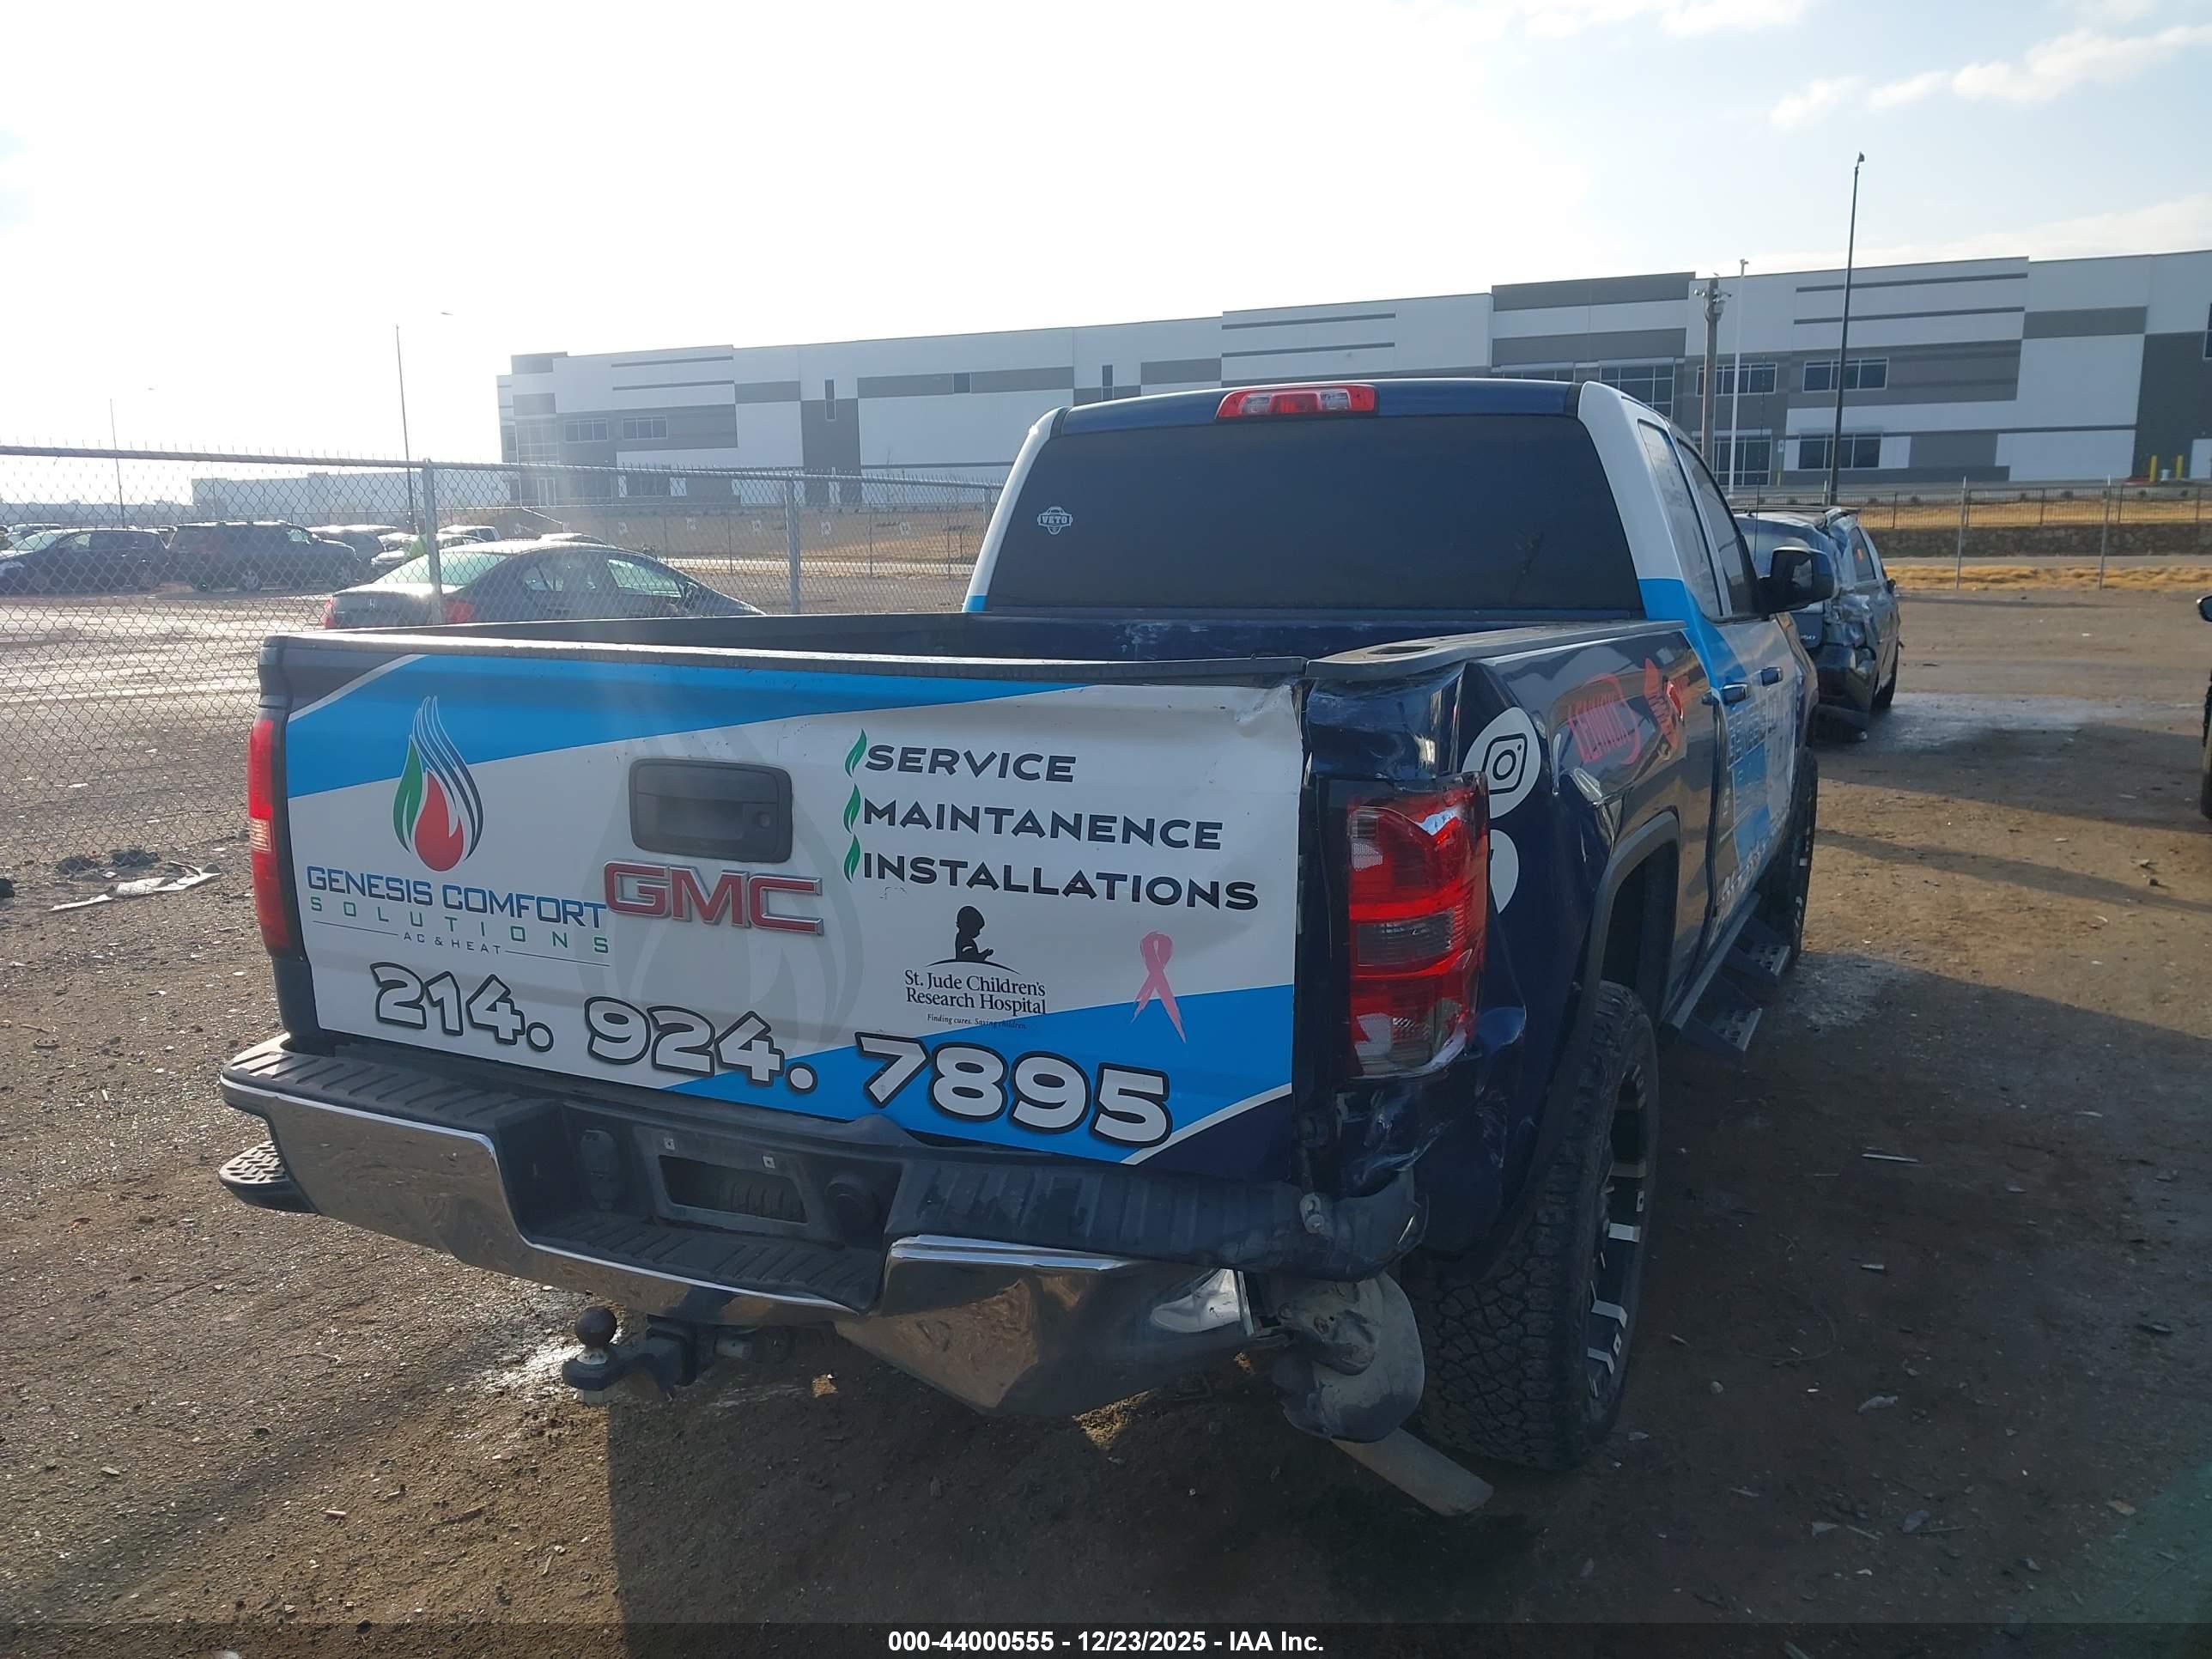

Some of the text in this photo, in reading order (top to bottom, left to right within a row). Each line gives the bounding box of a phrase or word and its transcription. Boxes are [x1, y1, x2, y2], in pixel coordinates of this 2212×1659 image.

[1042, 515, 1068, 524] VETO
[865, 744, 1077, 783] SERVICE
[864, 797, 1224, 850] MAINTANENCE
[307, 866, 607, 929] GENESIS COMFORT
[604, 860, 824, 936] GMC
[863, 852, 1260, 910] INSTALLATIONS
[310, 896, 610, 954] SOLUTIONS
[404, 932, 501, 954] AC & HEAT
[904, 969, 1046, 997] St. Jude Children's
[906, 988, 1047, 1017] Research Hospital
[927, 1013, 952, 1025] Finding
[370, 961, 1173, 1149] 214. 924. 7895
